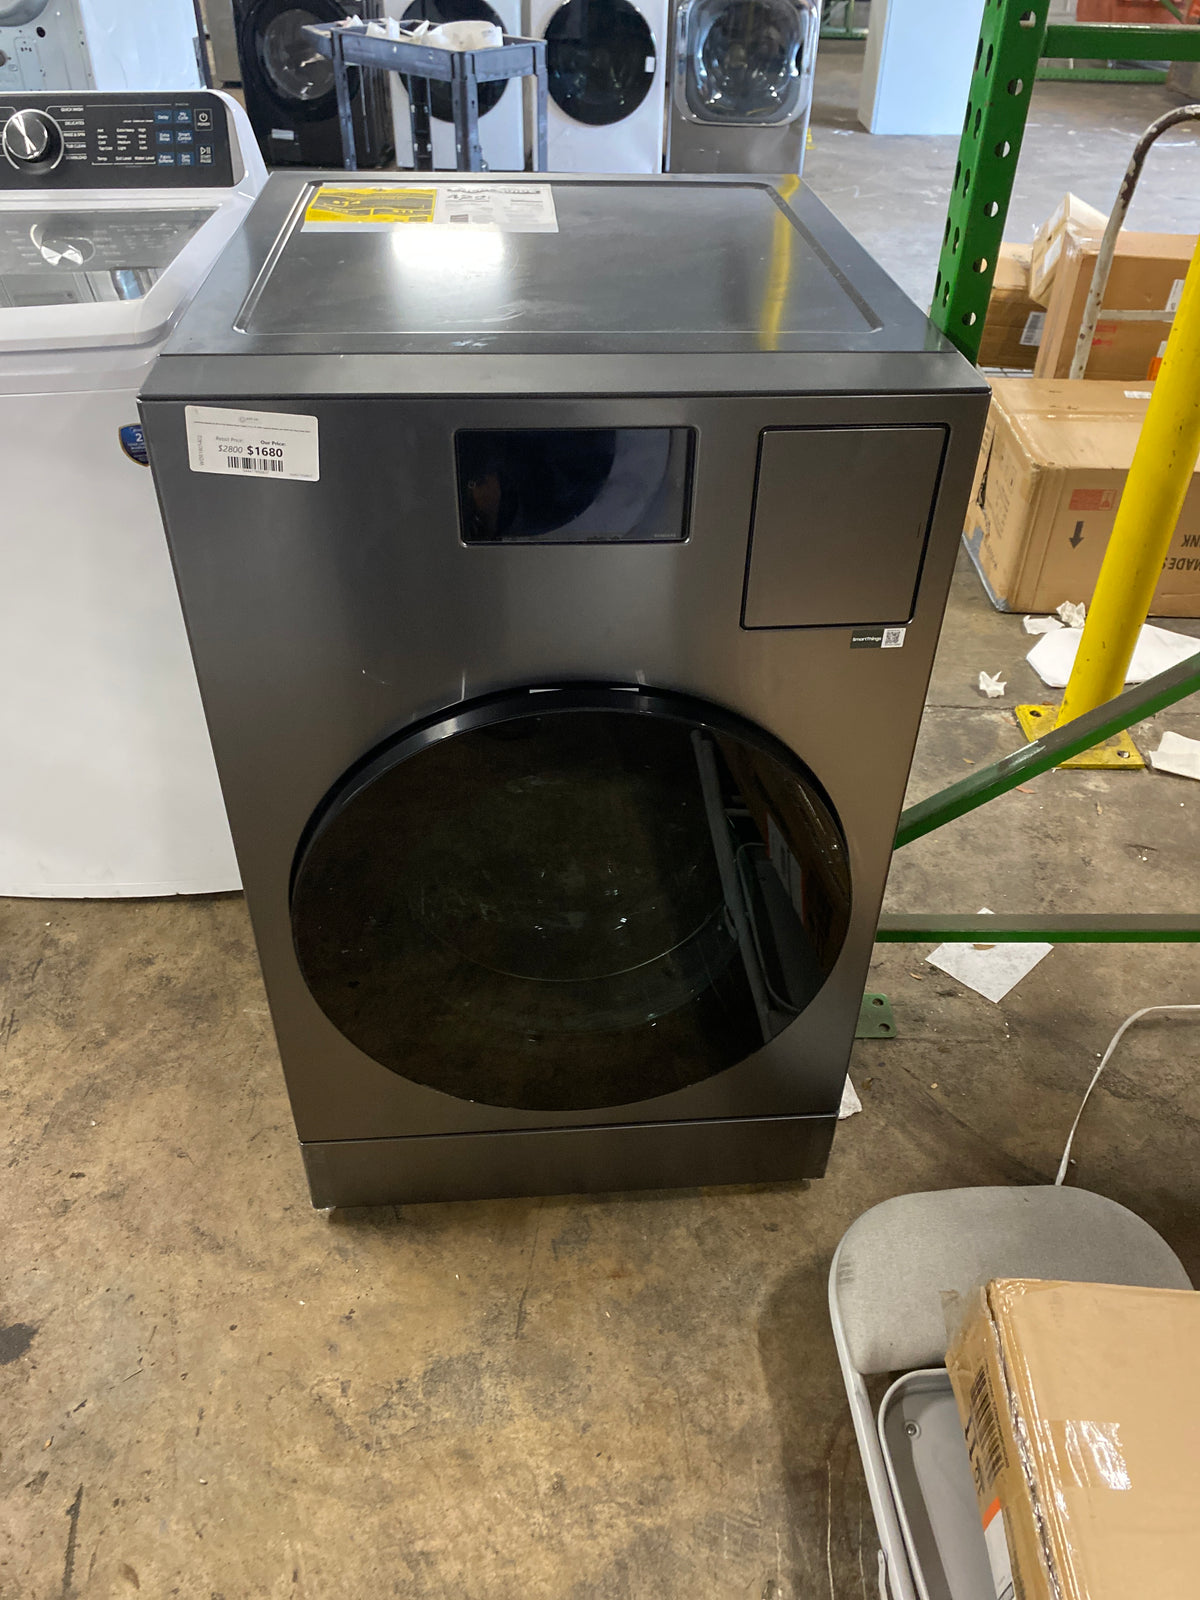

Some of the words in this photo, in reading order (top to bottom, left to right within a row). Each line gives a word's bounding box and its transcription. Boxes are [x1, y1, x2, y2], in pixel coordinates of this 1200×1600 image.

[218, 445, 244, 454] $2800
[247, 445, 283, 457] $1680
[1181, 534, 1200, 547] NK
